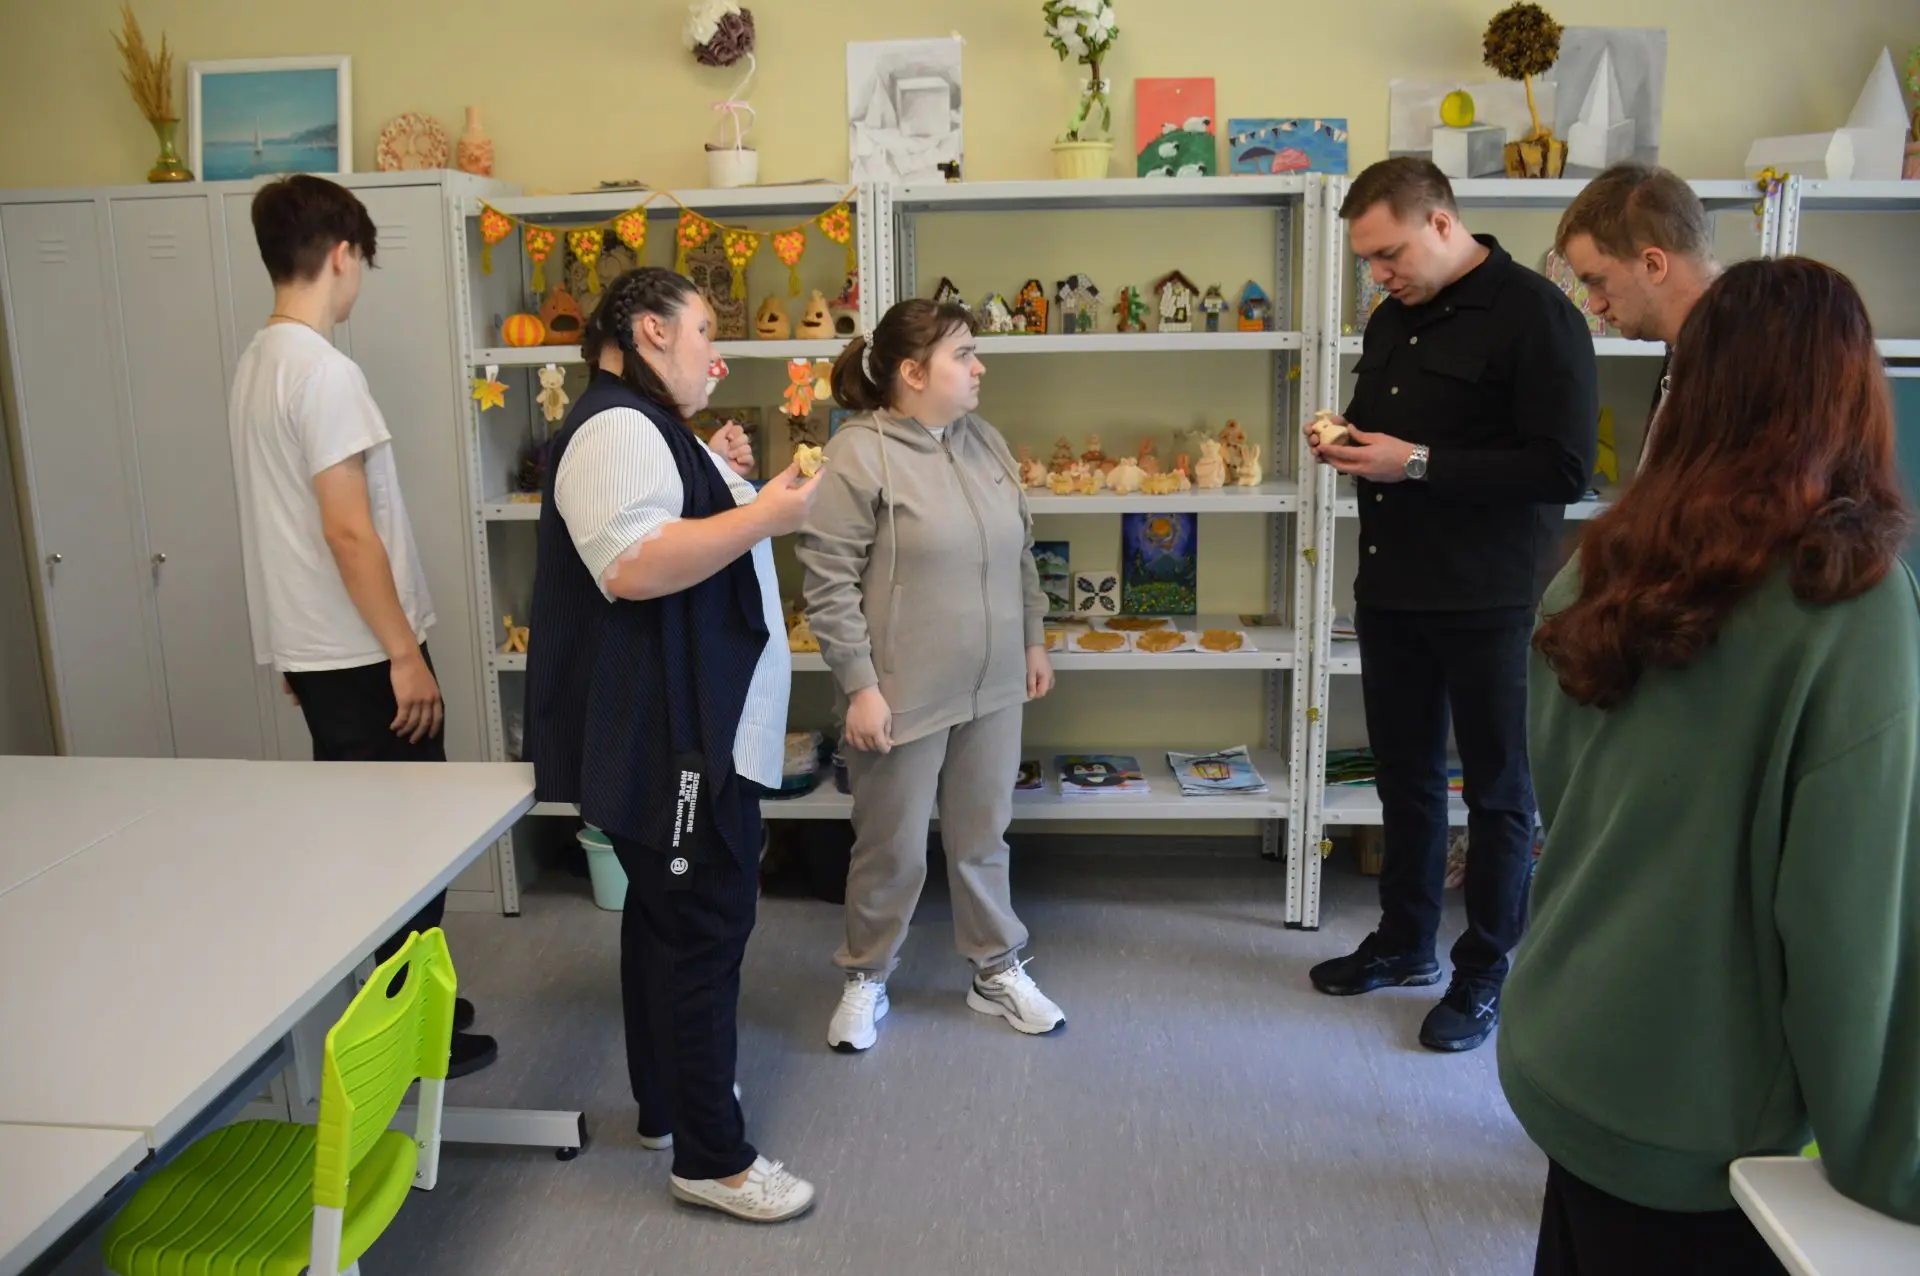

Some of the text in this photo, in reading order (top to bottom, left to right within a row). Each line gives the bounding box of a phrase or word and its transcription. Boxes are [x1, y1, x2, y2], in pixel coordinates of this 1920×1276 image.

[684, 771, 694, 802] IN THE
[687, 772, 700, 833] SOMEWHERE
[672, 799, 684, 847] UNIVERSE
